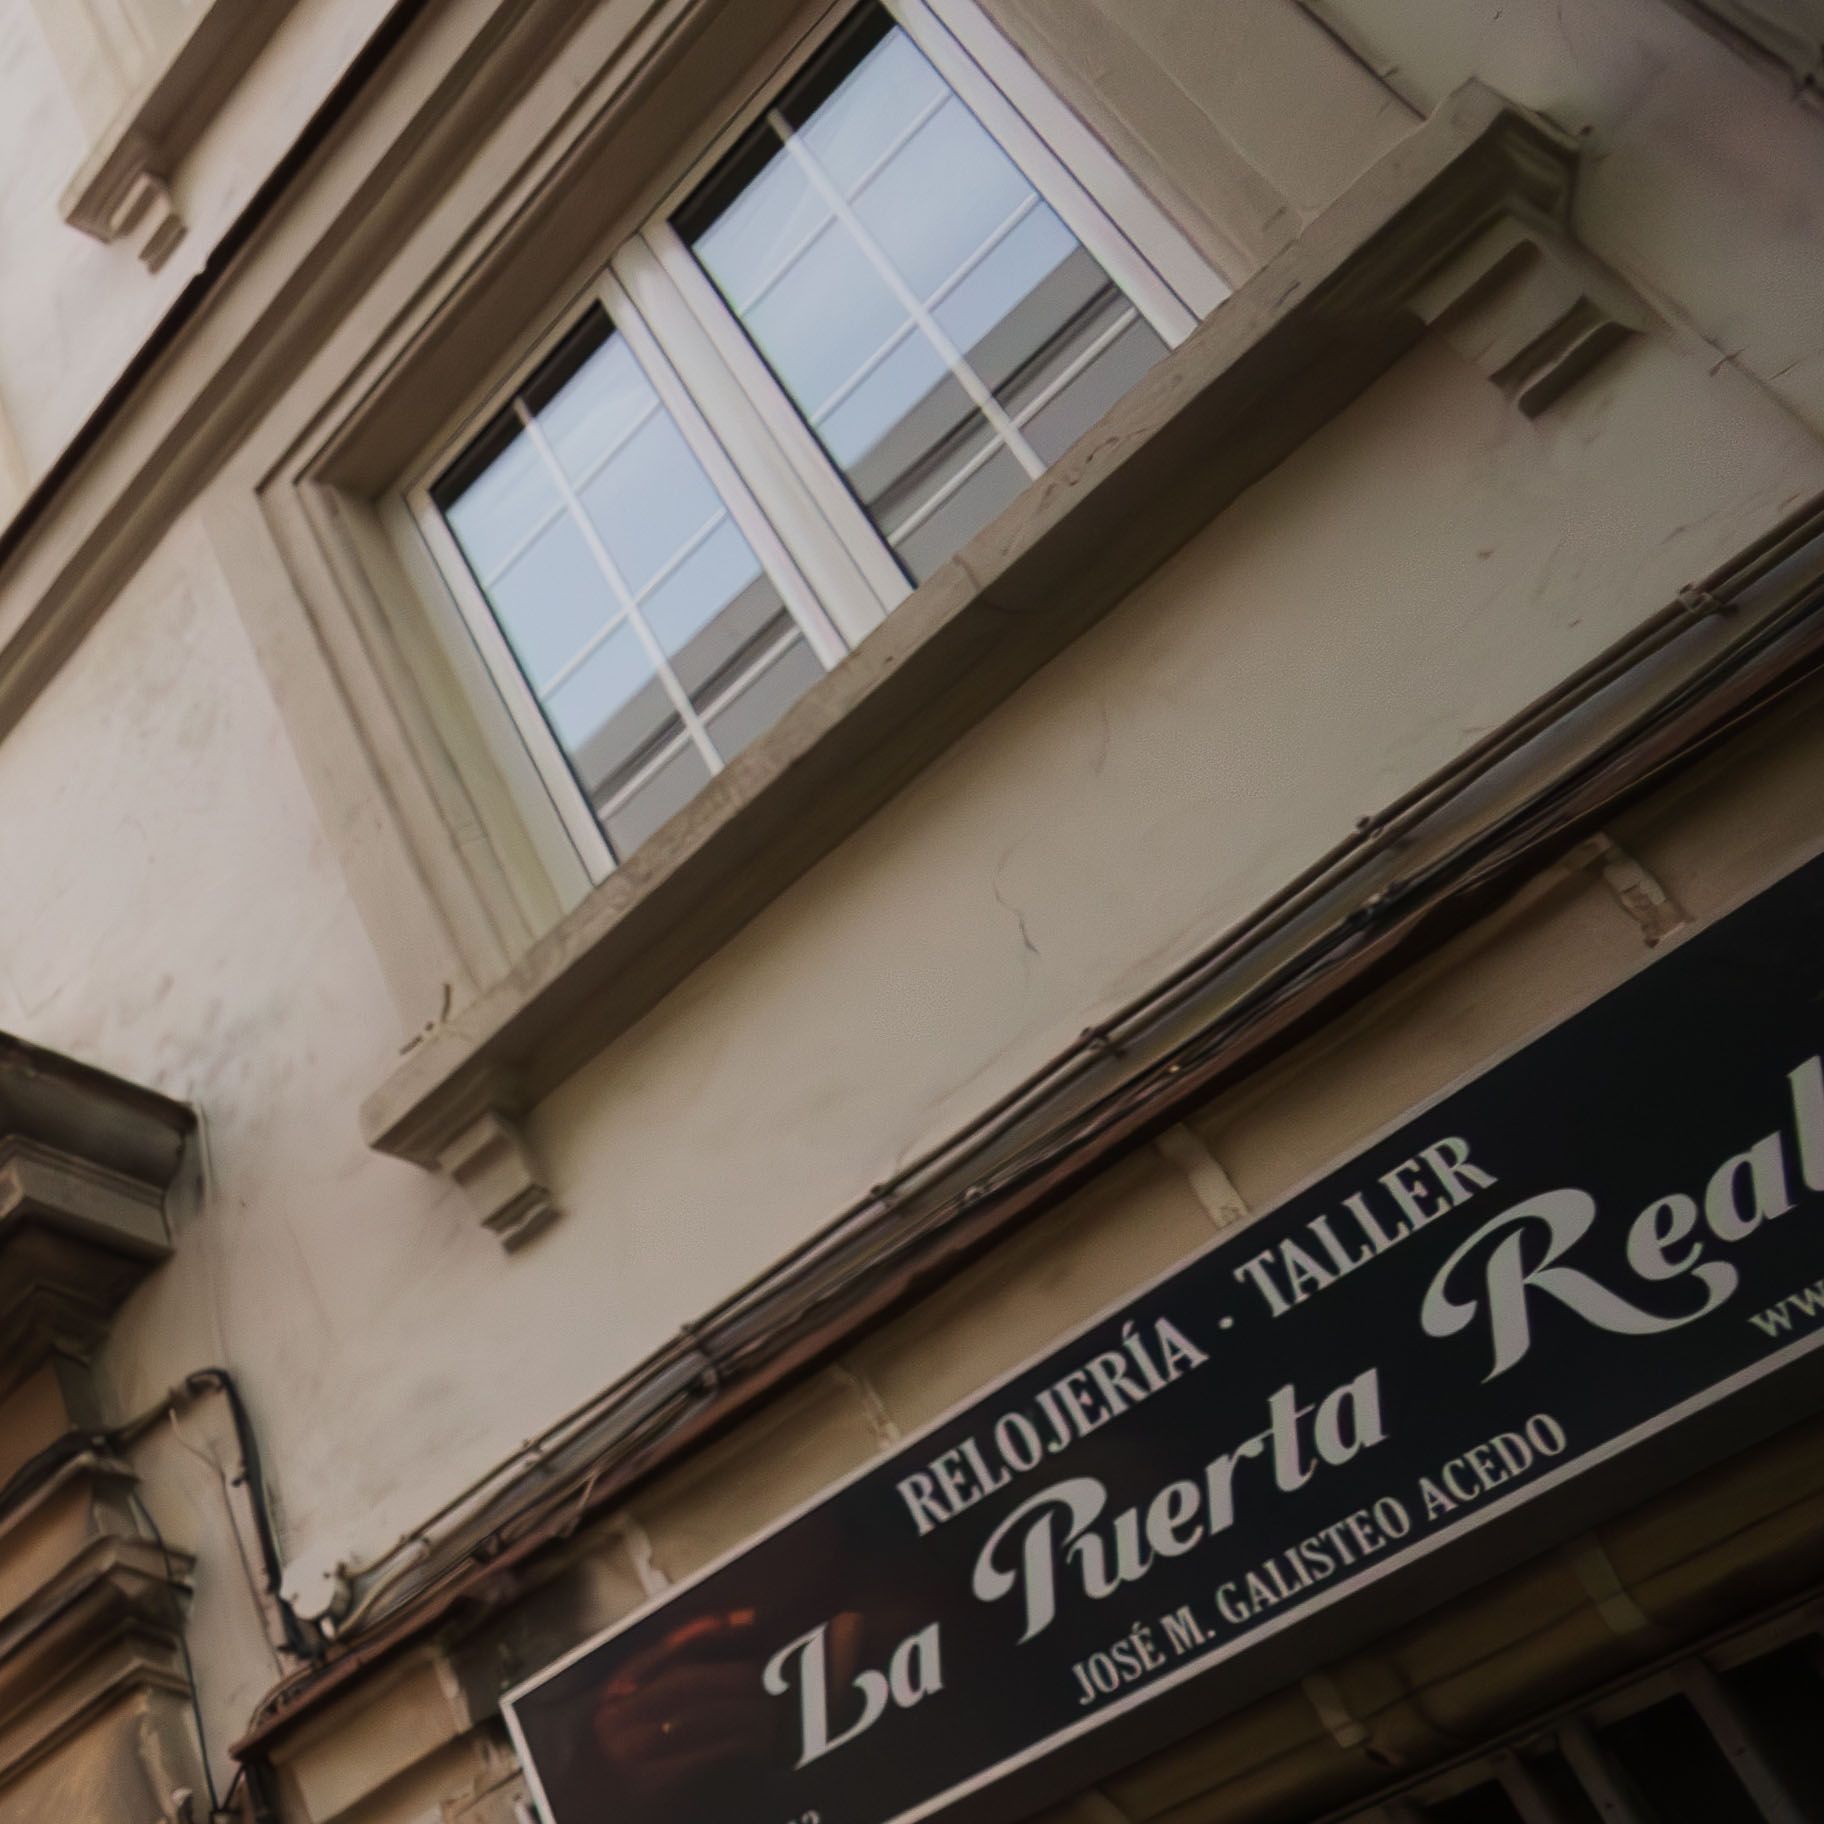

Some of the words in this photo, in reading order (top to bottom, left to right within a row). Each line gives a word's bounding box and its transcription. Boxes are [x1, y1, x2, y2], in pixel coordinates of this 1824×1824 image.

[762, 1620, 944, 1771] La
[971, 1366, 1391, 1646] Puerta
[1420, 1054, 1824, 1385] Real
[896, 1319, 1210, 1538] RELOJERÍA
[1233, 1135, 1499, 1318] TALLER
[1071, 1620, 1167, 1706] JOSÉ
[1160, 1603, 1217, 1657] M.
[1214, 1495, 1412, 1626] GALISTEO
[1417, 1412, 1567, 1522] ACEDO
